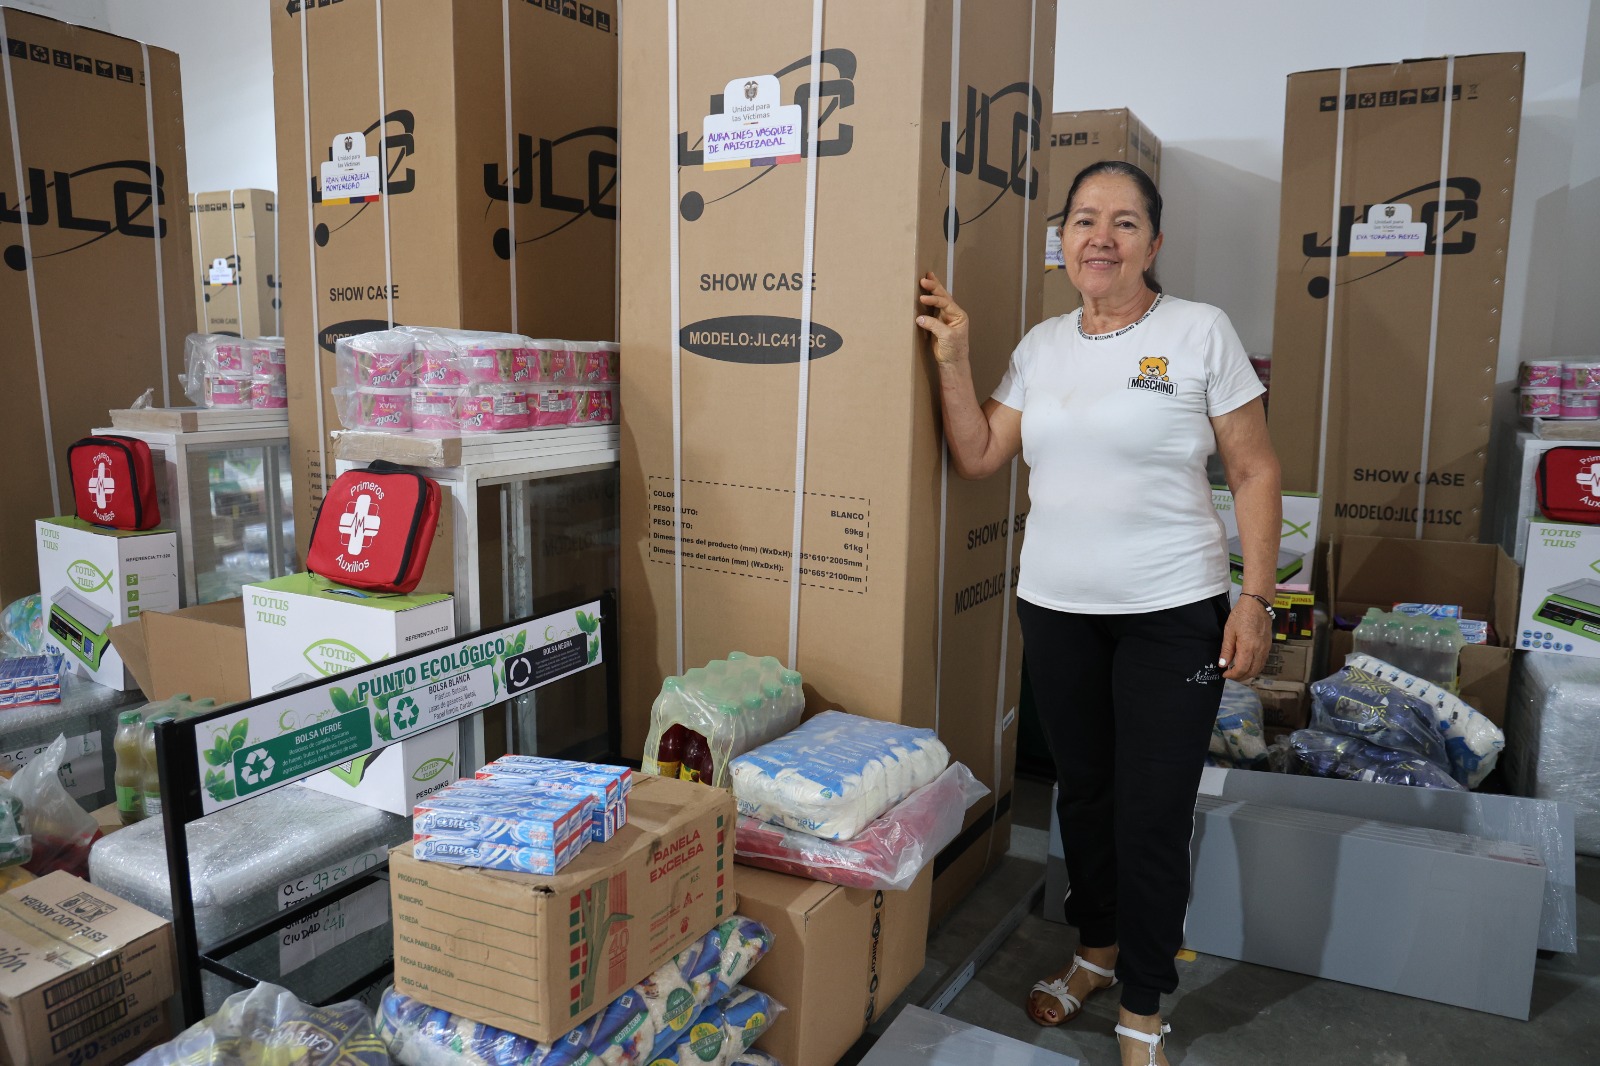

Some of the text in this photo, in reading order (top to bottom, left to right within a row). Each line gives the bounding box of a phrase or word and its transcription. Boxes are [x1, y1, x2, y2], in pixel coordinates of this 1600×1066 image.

[731, 103, 771, 114] Unidad para
[731, 115, 742, 123] las
[707, 125, 794, 143] AURA INES VASQUEZ
[708, 137, 786, 154] DE ARISTIZABAL
[700, 273, 758, 292] SHOW
[330, 287, 364, 302] SHOW
[372, 370, 400, 386] Scott
[424, 367, 447, 383] Scott
[1130, 378, 1174, 395] MOSCHINO
[379, 402, 397, 410] MAX
[375, 412, 402, 426] Scott
[1353, 468, 1409, 484] SHOW
[350, 480, 385, 500] Primeros
[653, 504, 864, 538] PESO 69kg
[830, 510, 864, 521] BLANCO
[40, 528, 60, 540] TOTUS
[653, 518, 864, 554] PESO 61kg
[967, 512, 1026, 550] SHOW CSE
[1540, 528, 1582, 538] TOTUS
[42, 540, 59, 552] TUUS
[696, 538, 706, 546] del
[708, 540, 739, 551] producto
[1543, 538, 1577, 549] TUUS
[335, 554, 370, 573] Auxilios
[696, 552, 706, 560] del
[708, 555, 730, 564] cartón
[74, 564, 96, 578] TOTUS
[252, 594, 289, 612] TOTUS
[256, 611, 287, 626] TUUS
[318, 645, 356, 663] TOTUS
[542, 644, 558, 656] BOLSA
[357, 666, 417, 702] PUNTO
[420, 637, 506, 682] ECOLÓGICO
[428, 673, 471, 695] BOLSA BLANCA
[295, 721, 342, 744] BOLSA VERDE
[420, 762, 439, 773] TOTUS
[425, 813, 480, 832] James
[426, 841, 480, 858] James
[653, 829, 701, 865] PANELA
[650, 842, 704, 884] EXCELSA
[398, 872, 429, 888] PRODUCTOR
[398, 893, 424, 906] MUNICIPIO
[20, 894, 108, 942] ESTE LADO ARRIBA
[398, 914, 419, 926] VEREDA
[283, 922, 320, 946] CIUDAD
[400, 934, 442, 953] FINCA PANELERA
[400, 955, 417, 968] FECHA
[400, 976, 429, 992] PESO CAJA
